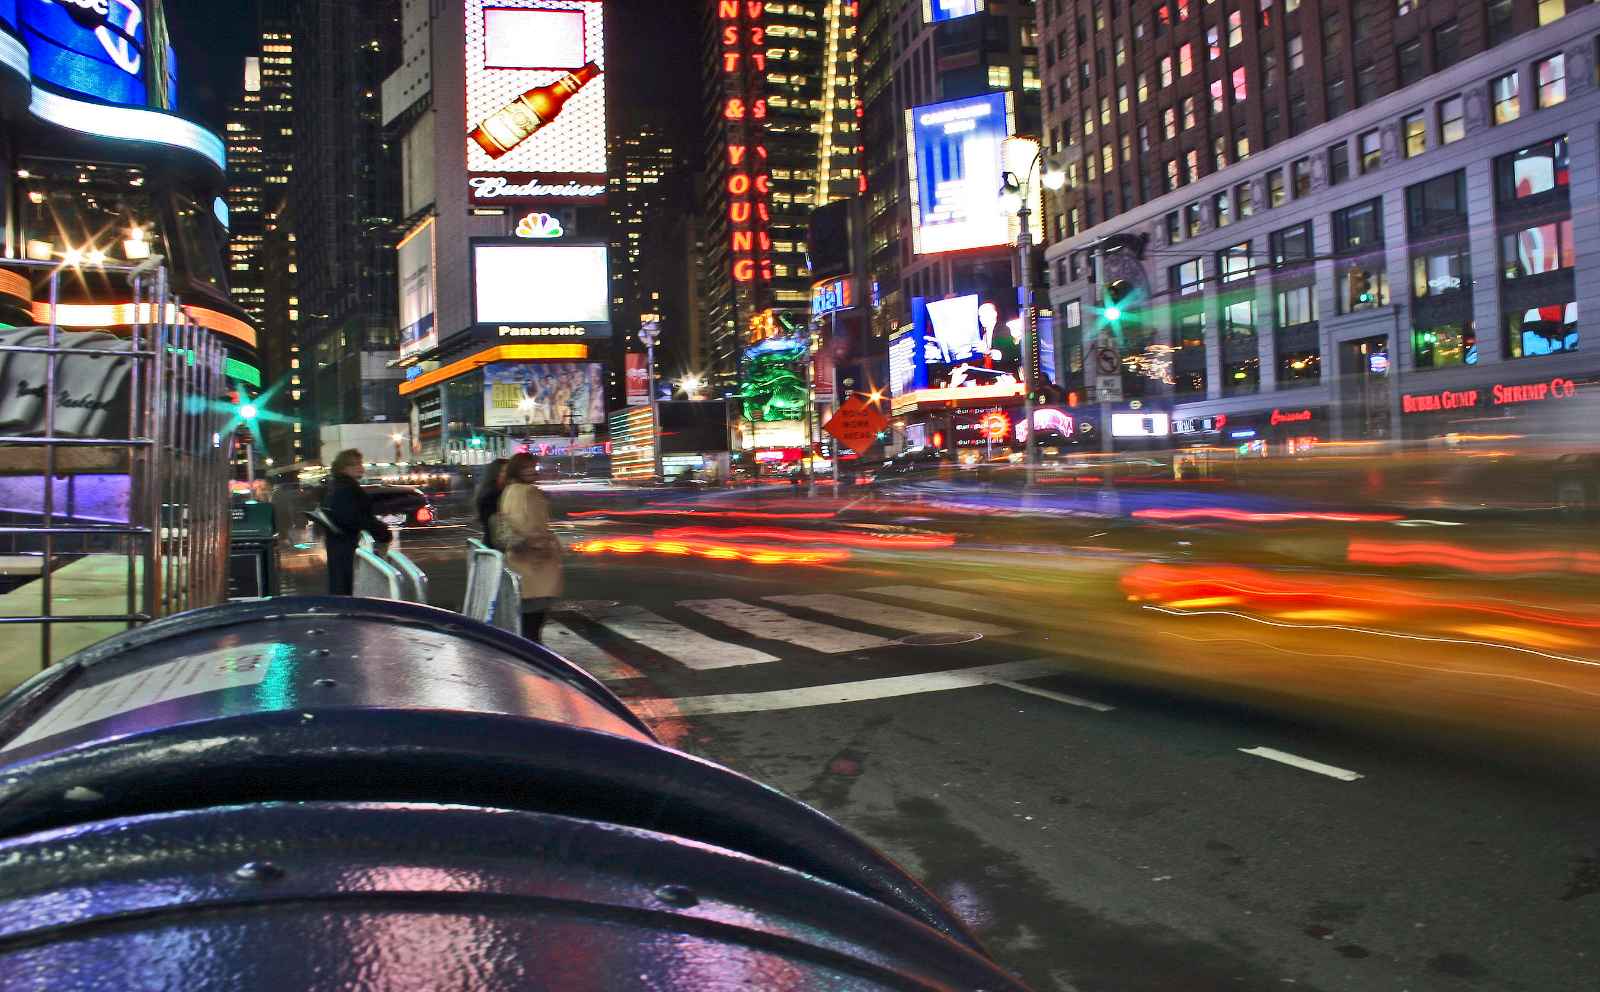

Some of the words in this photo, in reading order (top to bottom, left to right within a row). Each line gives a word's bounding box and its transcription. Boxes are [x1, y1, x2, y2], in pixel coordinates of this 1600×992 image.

[724, 98, 745, 118] &
[468, 176, 606, 197] Budweiser
[728, 145, 754, 281] YOUNG
[498, 325, 586, 337] Panasonic
